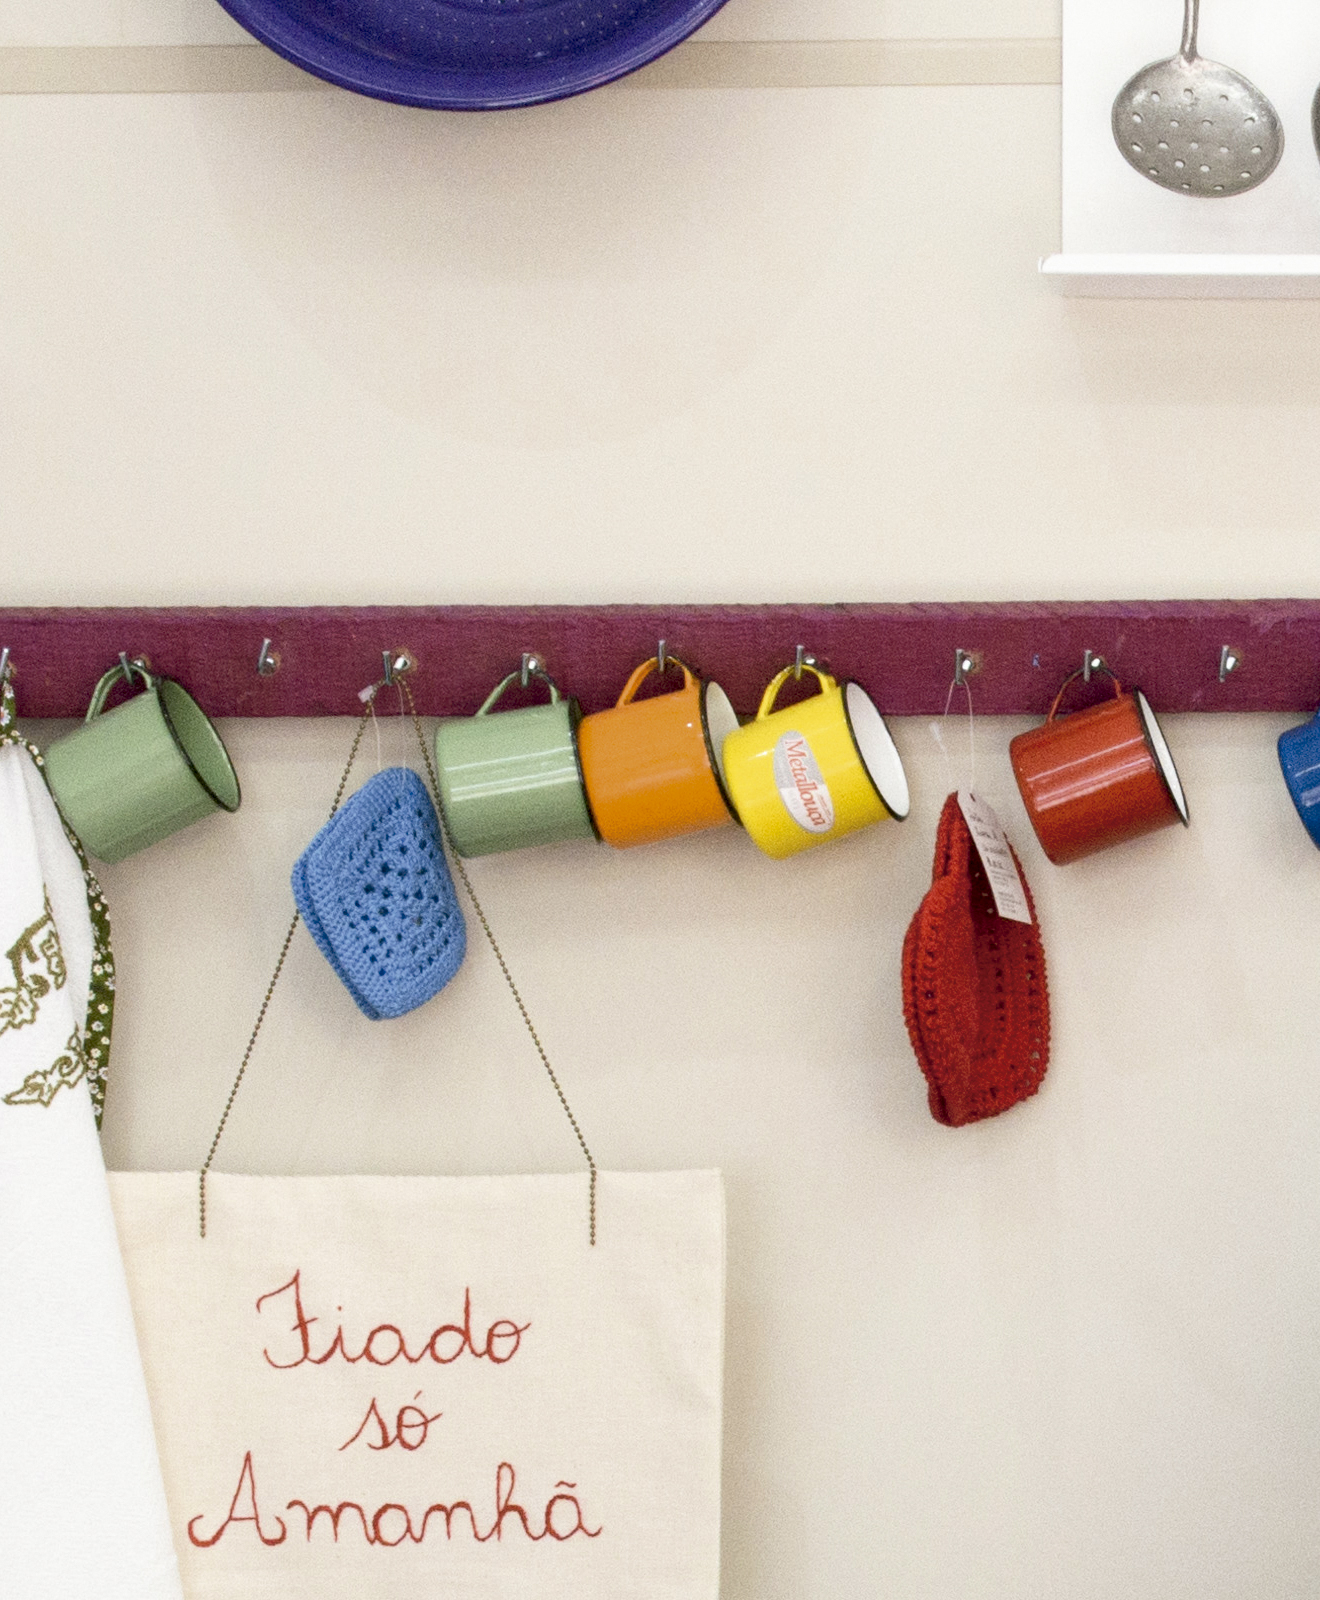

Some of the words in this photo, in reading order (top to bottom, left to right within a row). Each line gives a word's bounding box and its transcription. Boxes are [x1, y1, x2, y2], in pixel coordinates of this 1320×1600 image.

[256, 1268, 532, 1369] Fiado
[338, 1390, 444, 1451] só
[187, 1450, 603, 1548] Amanhã
